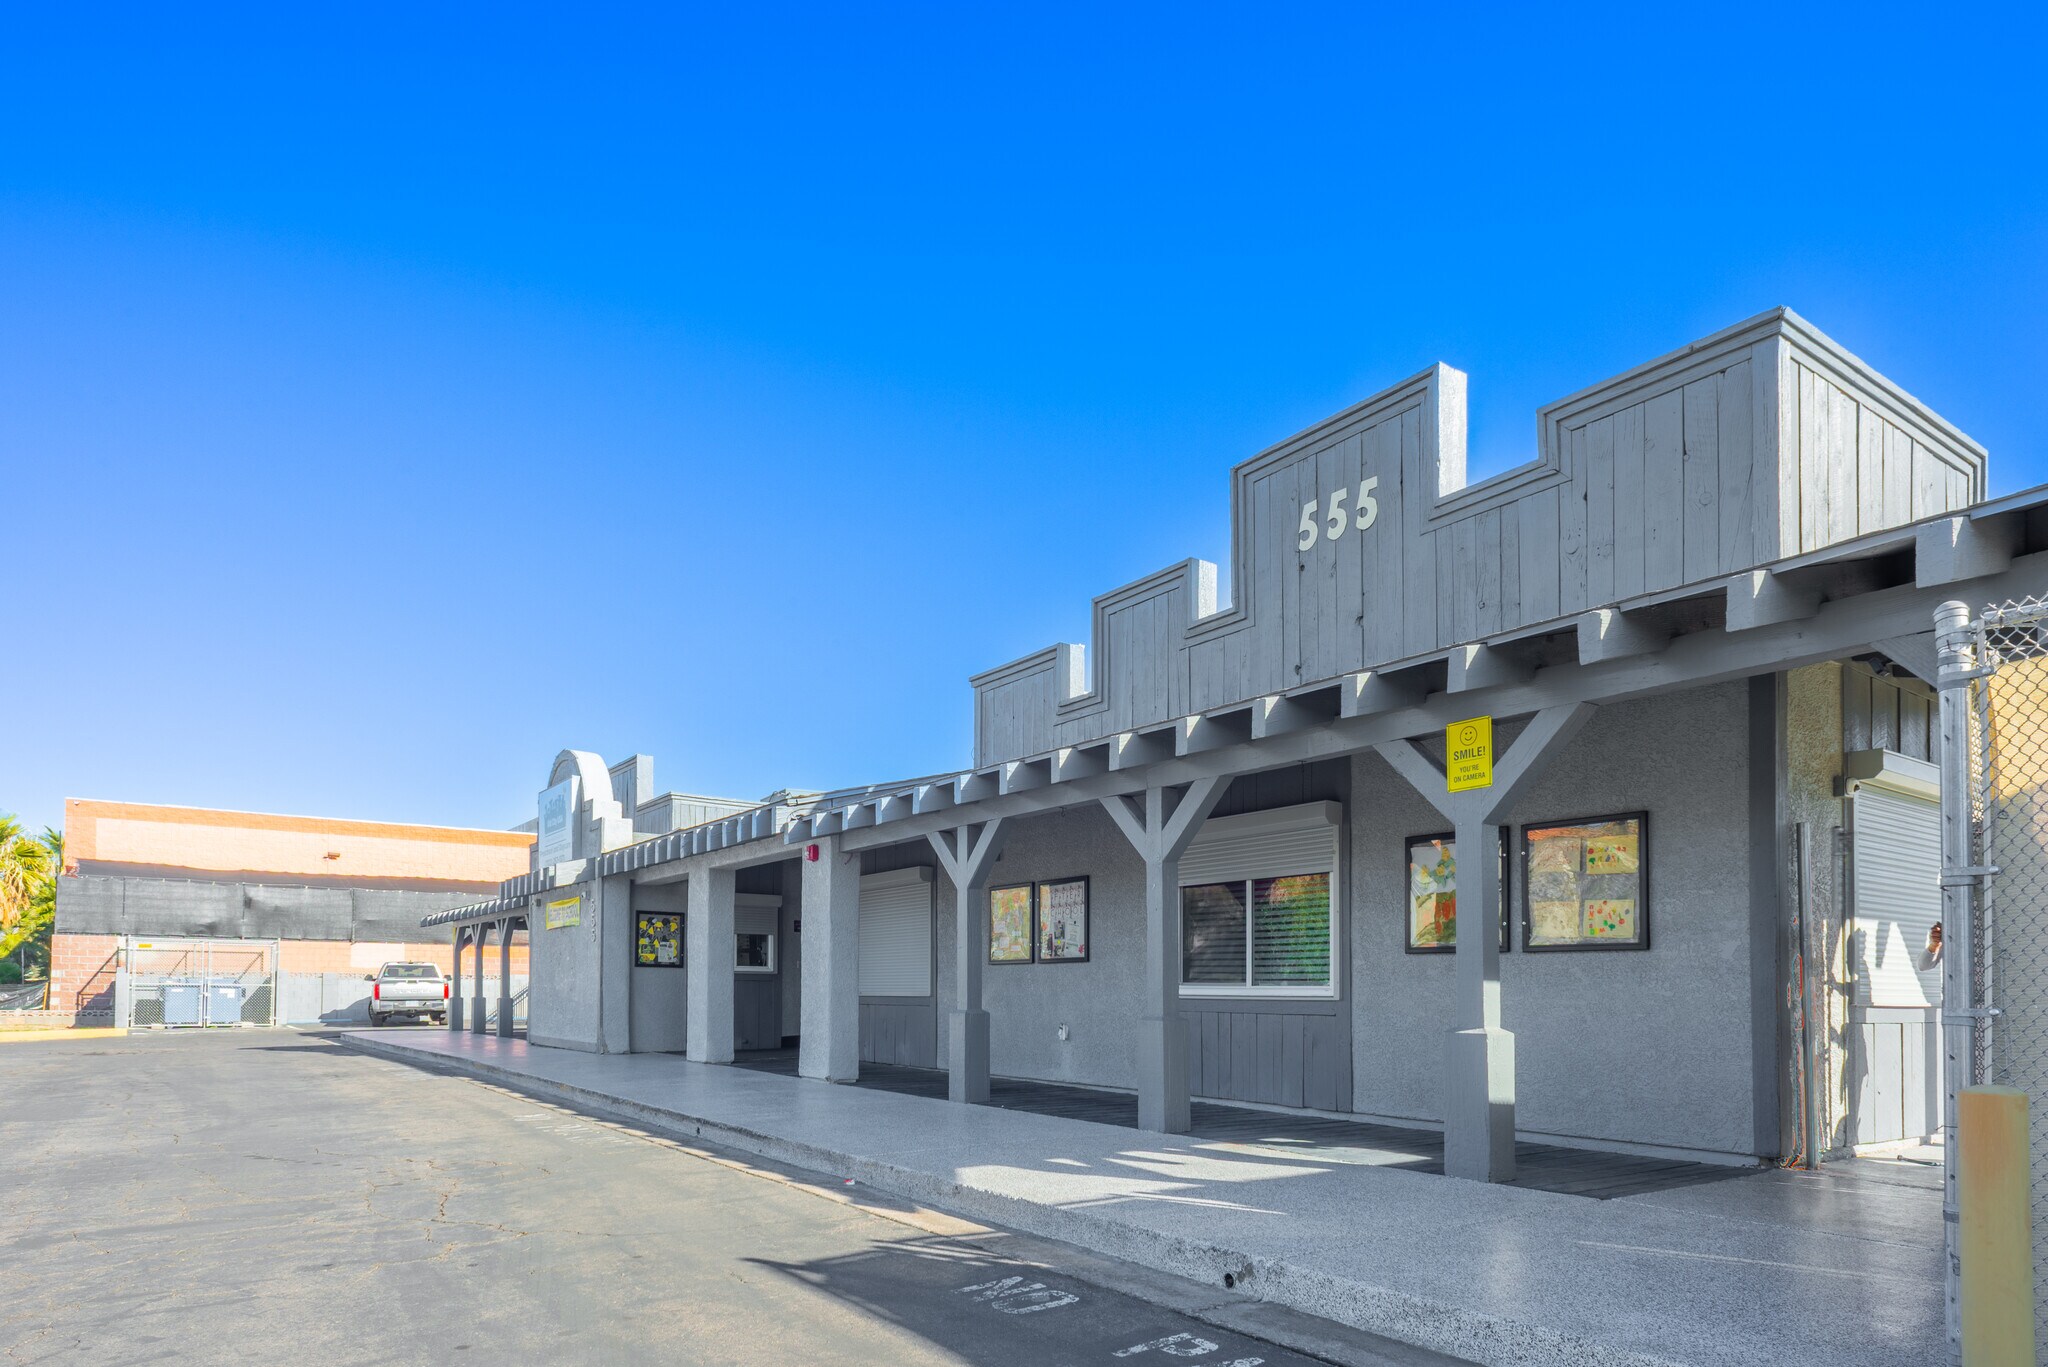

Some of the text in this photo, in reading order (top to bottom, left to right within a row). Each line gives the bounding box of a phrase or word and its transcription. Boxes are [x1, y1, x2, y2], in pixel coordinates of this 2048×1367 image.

[1299, 475, 1378, 551] 555
[1453, 746, 1486, 761] SMILE!
[1459, 763, 1479, 773] YOU'RE
[1462, 772, 1486, 781] CAMERA
[950, 1276, 1079, 1314] NO
